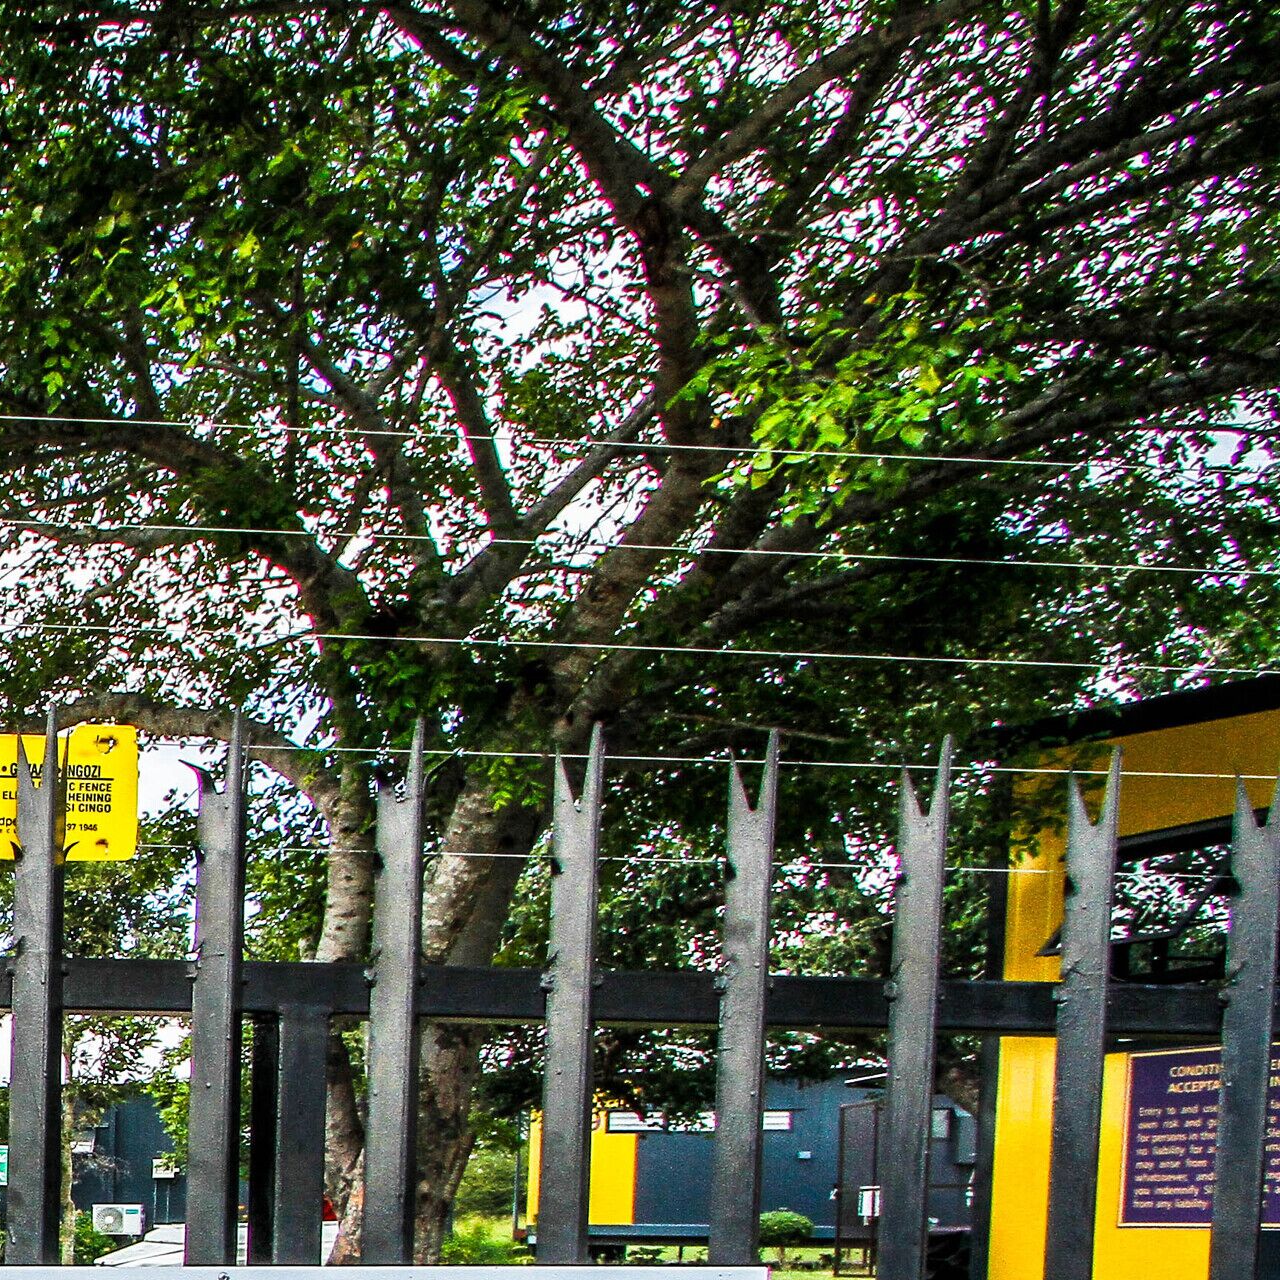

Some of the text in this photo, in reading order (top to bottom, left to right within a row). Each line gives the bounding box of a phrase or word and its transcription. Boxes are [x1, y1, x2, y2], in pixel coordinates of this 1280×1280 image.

[68, 765, 101, 779] NGOZI
[79, 782, 112, 792] FENCE
[68, 793, 112, 803] HEINING
[78, 803, 112, 813] CINGO
